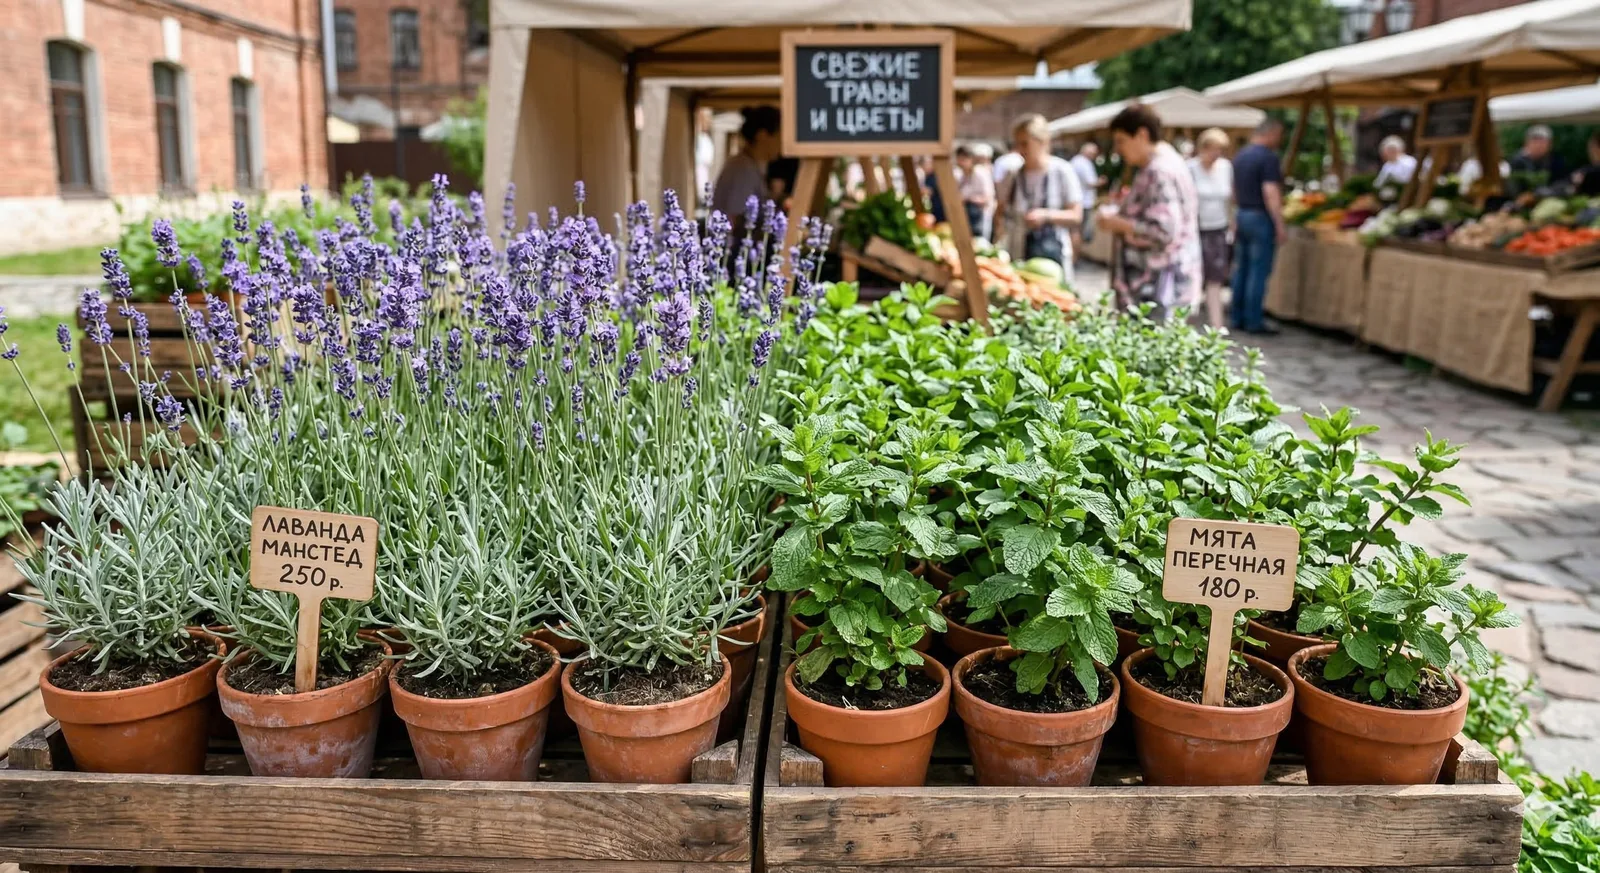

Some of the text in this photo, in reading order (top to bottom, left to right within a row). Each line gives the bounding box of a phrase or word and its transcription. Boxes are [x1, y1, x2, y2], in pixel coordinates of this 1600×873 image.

[810, 51, 921, 80] СВЕЖИЕ
[824, 79, 910, 105] ТРАВЫ
[810, 106, 925, 136] И ЦВЕТЫ
[262, 514, 365, 544] ЛАВАНДА
[1189, 527, 1257, 550] МЯТА
[261, 538, 363, 569] МАНСТЕД
[1172, 550, 1286, 576] ПЕРЕЧНАЯ
[279, 563, 344, 591] 250 р.
[1198, 576, 1241, 598] 180
